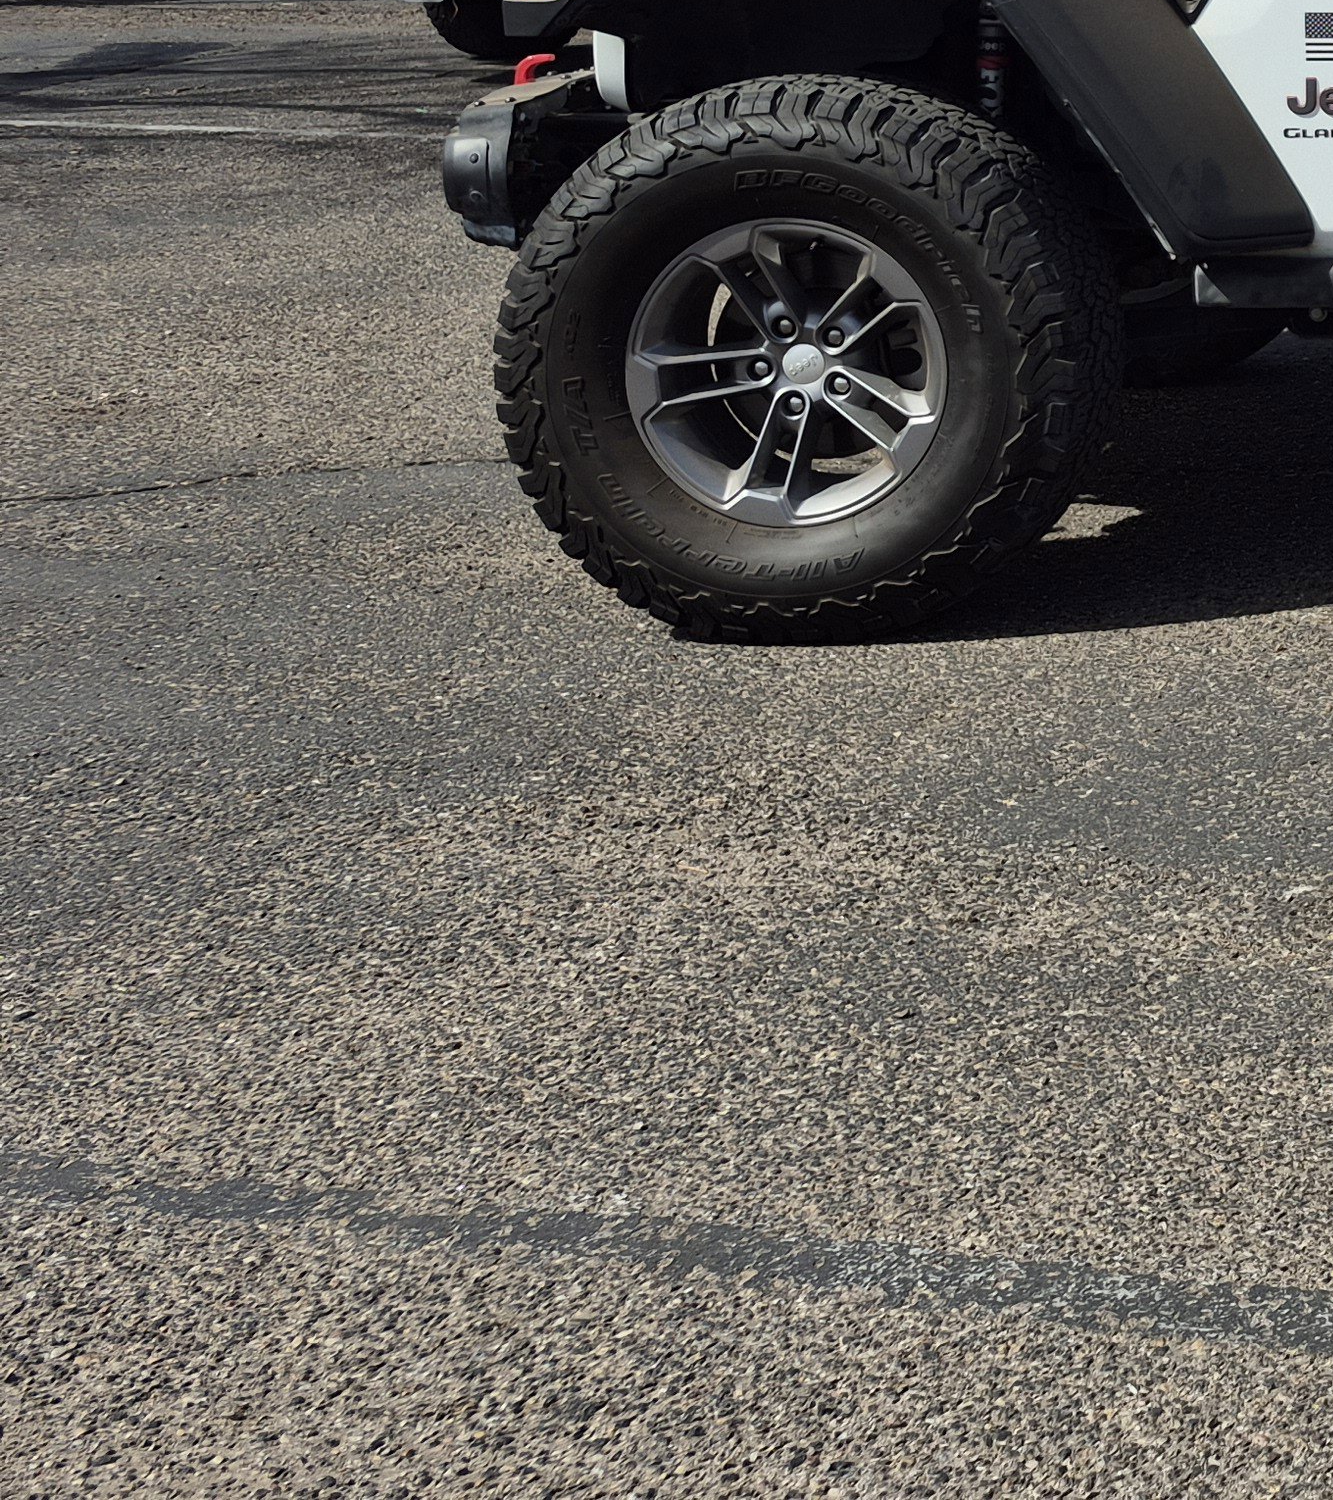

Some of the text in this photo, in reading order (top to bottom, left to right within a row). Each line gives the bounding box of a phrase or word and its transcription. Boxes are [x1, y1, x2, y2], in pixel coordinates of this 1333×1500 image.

[734, 168, 985, 334] BFGoodrich
[562, 376, 600, 457] T/A
[597, 473, 866, 582] All-Terrain
